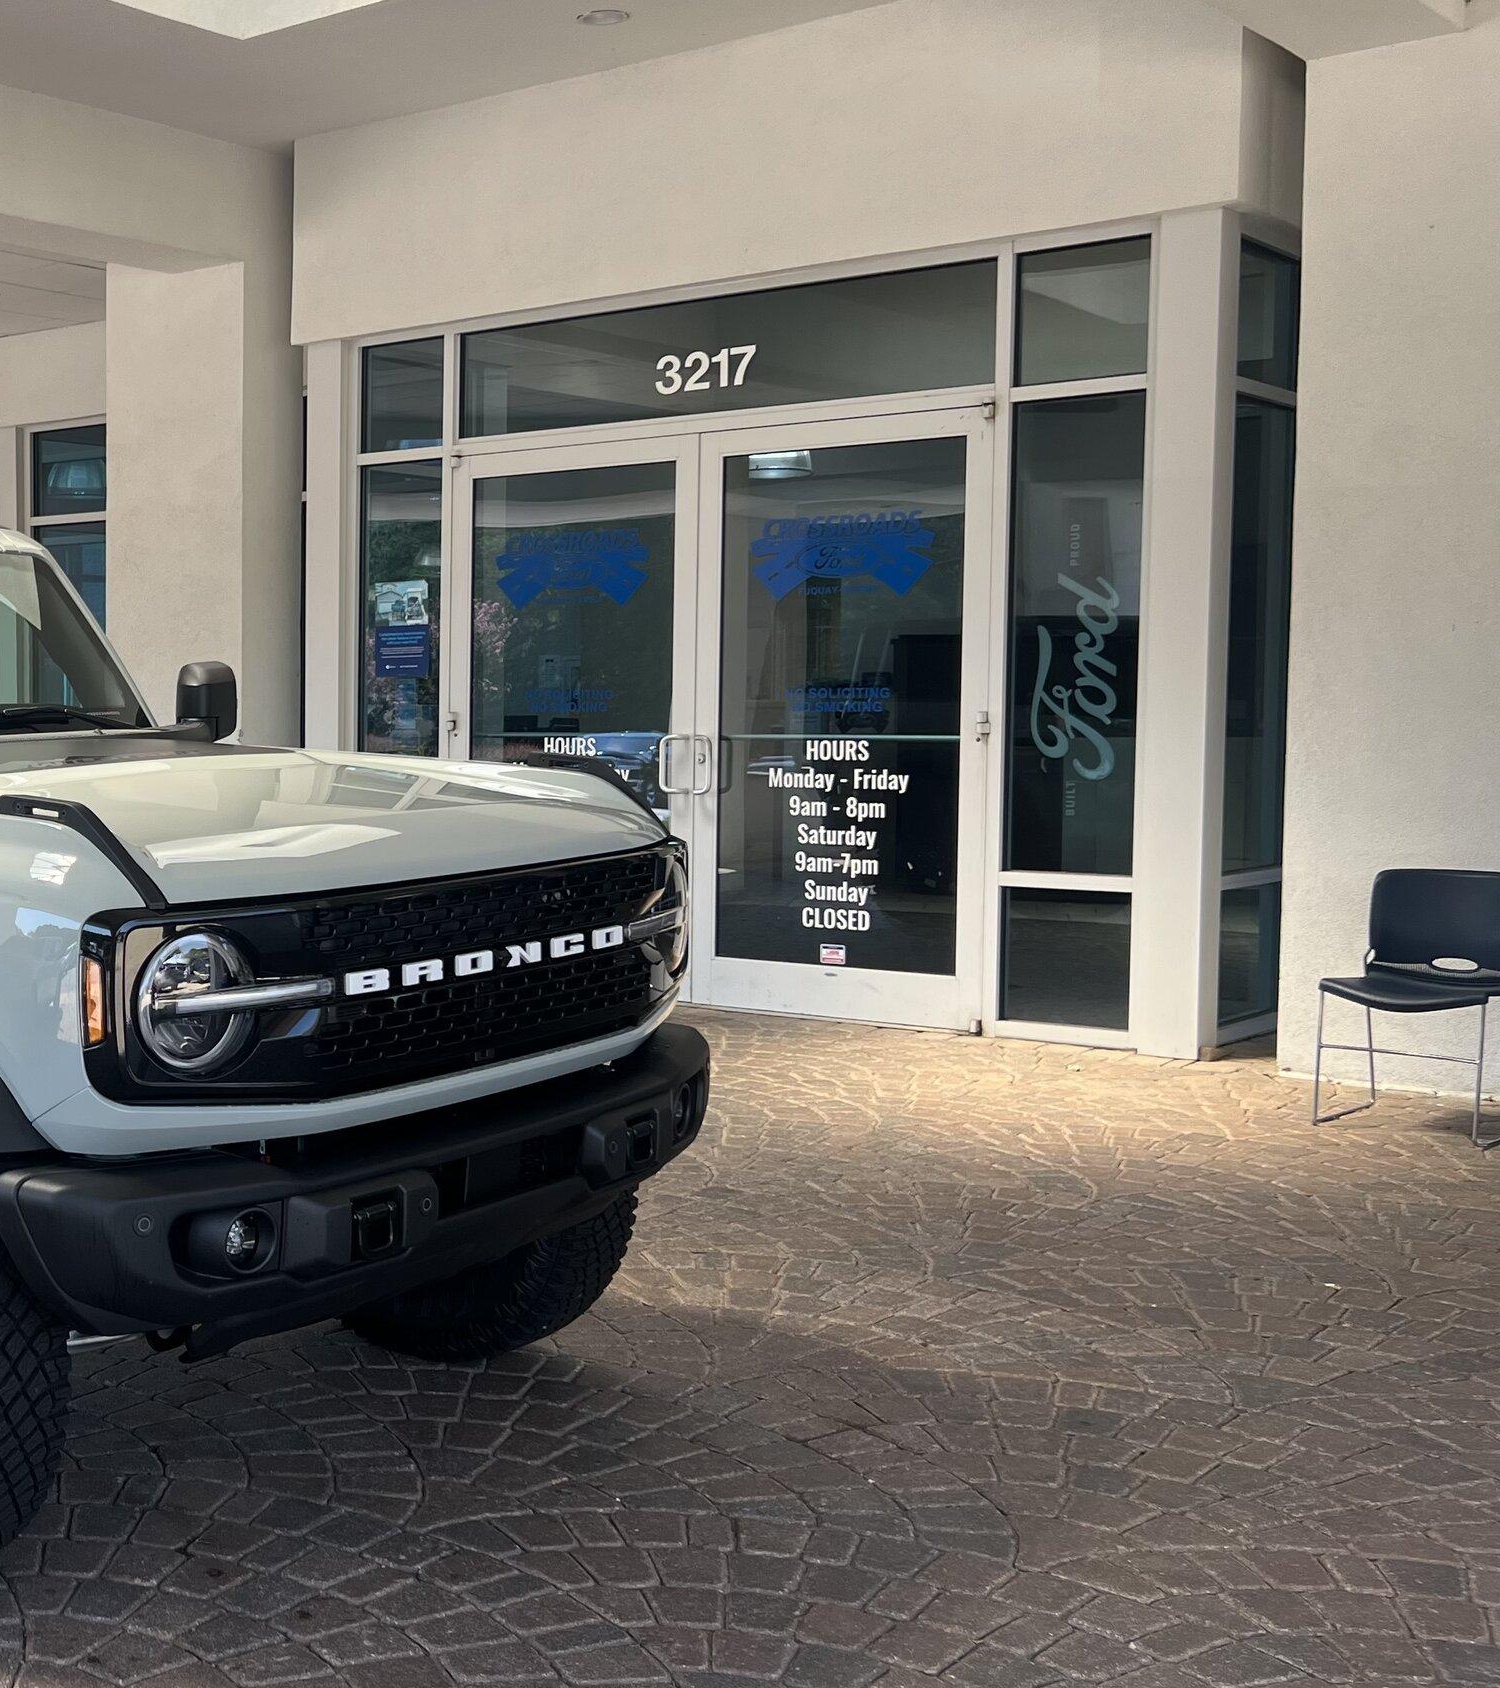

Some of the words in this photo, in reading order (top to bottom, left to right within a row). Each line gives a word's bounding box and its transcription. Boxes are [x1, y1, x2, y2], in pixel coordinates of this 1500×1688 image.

[655, 344, 757, 395] 3217
[762, 510, 922, 541] CROSSROADS
[1069, 523, 1080, 567] PROUD
[1030, 573, 1120, 781] Ford
[784, 687, 804, 699] NO
[808, 687, 891, 699] SOLICITING
[792, 701, 811, 713] NO
[814, 701, 884, 713] SMOKING
[544, 737, 596, 756] HOURS
[806, 739, 870, 761] HOURS
[768, 767, 835, 792] Monday
[854, 768, 910, 794] Friday
[789, 795, 827, 817] 9am
[846, 796, 887, 822] 8pm
[1065, 781, 1076, 816] BUILT
[797, 823, 878, 850] Saturday
[794, 851, 879, 879] 9am-7pm
[804, 879, 870, 906] Sunday
[802, 907, 871, 931] CLOSED
[344, 924, 624, 995] BRONCO
